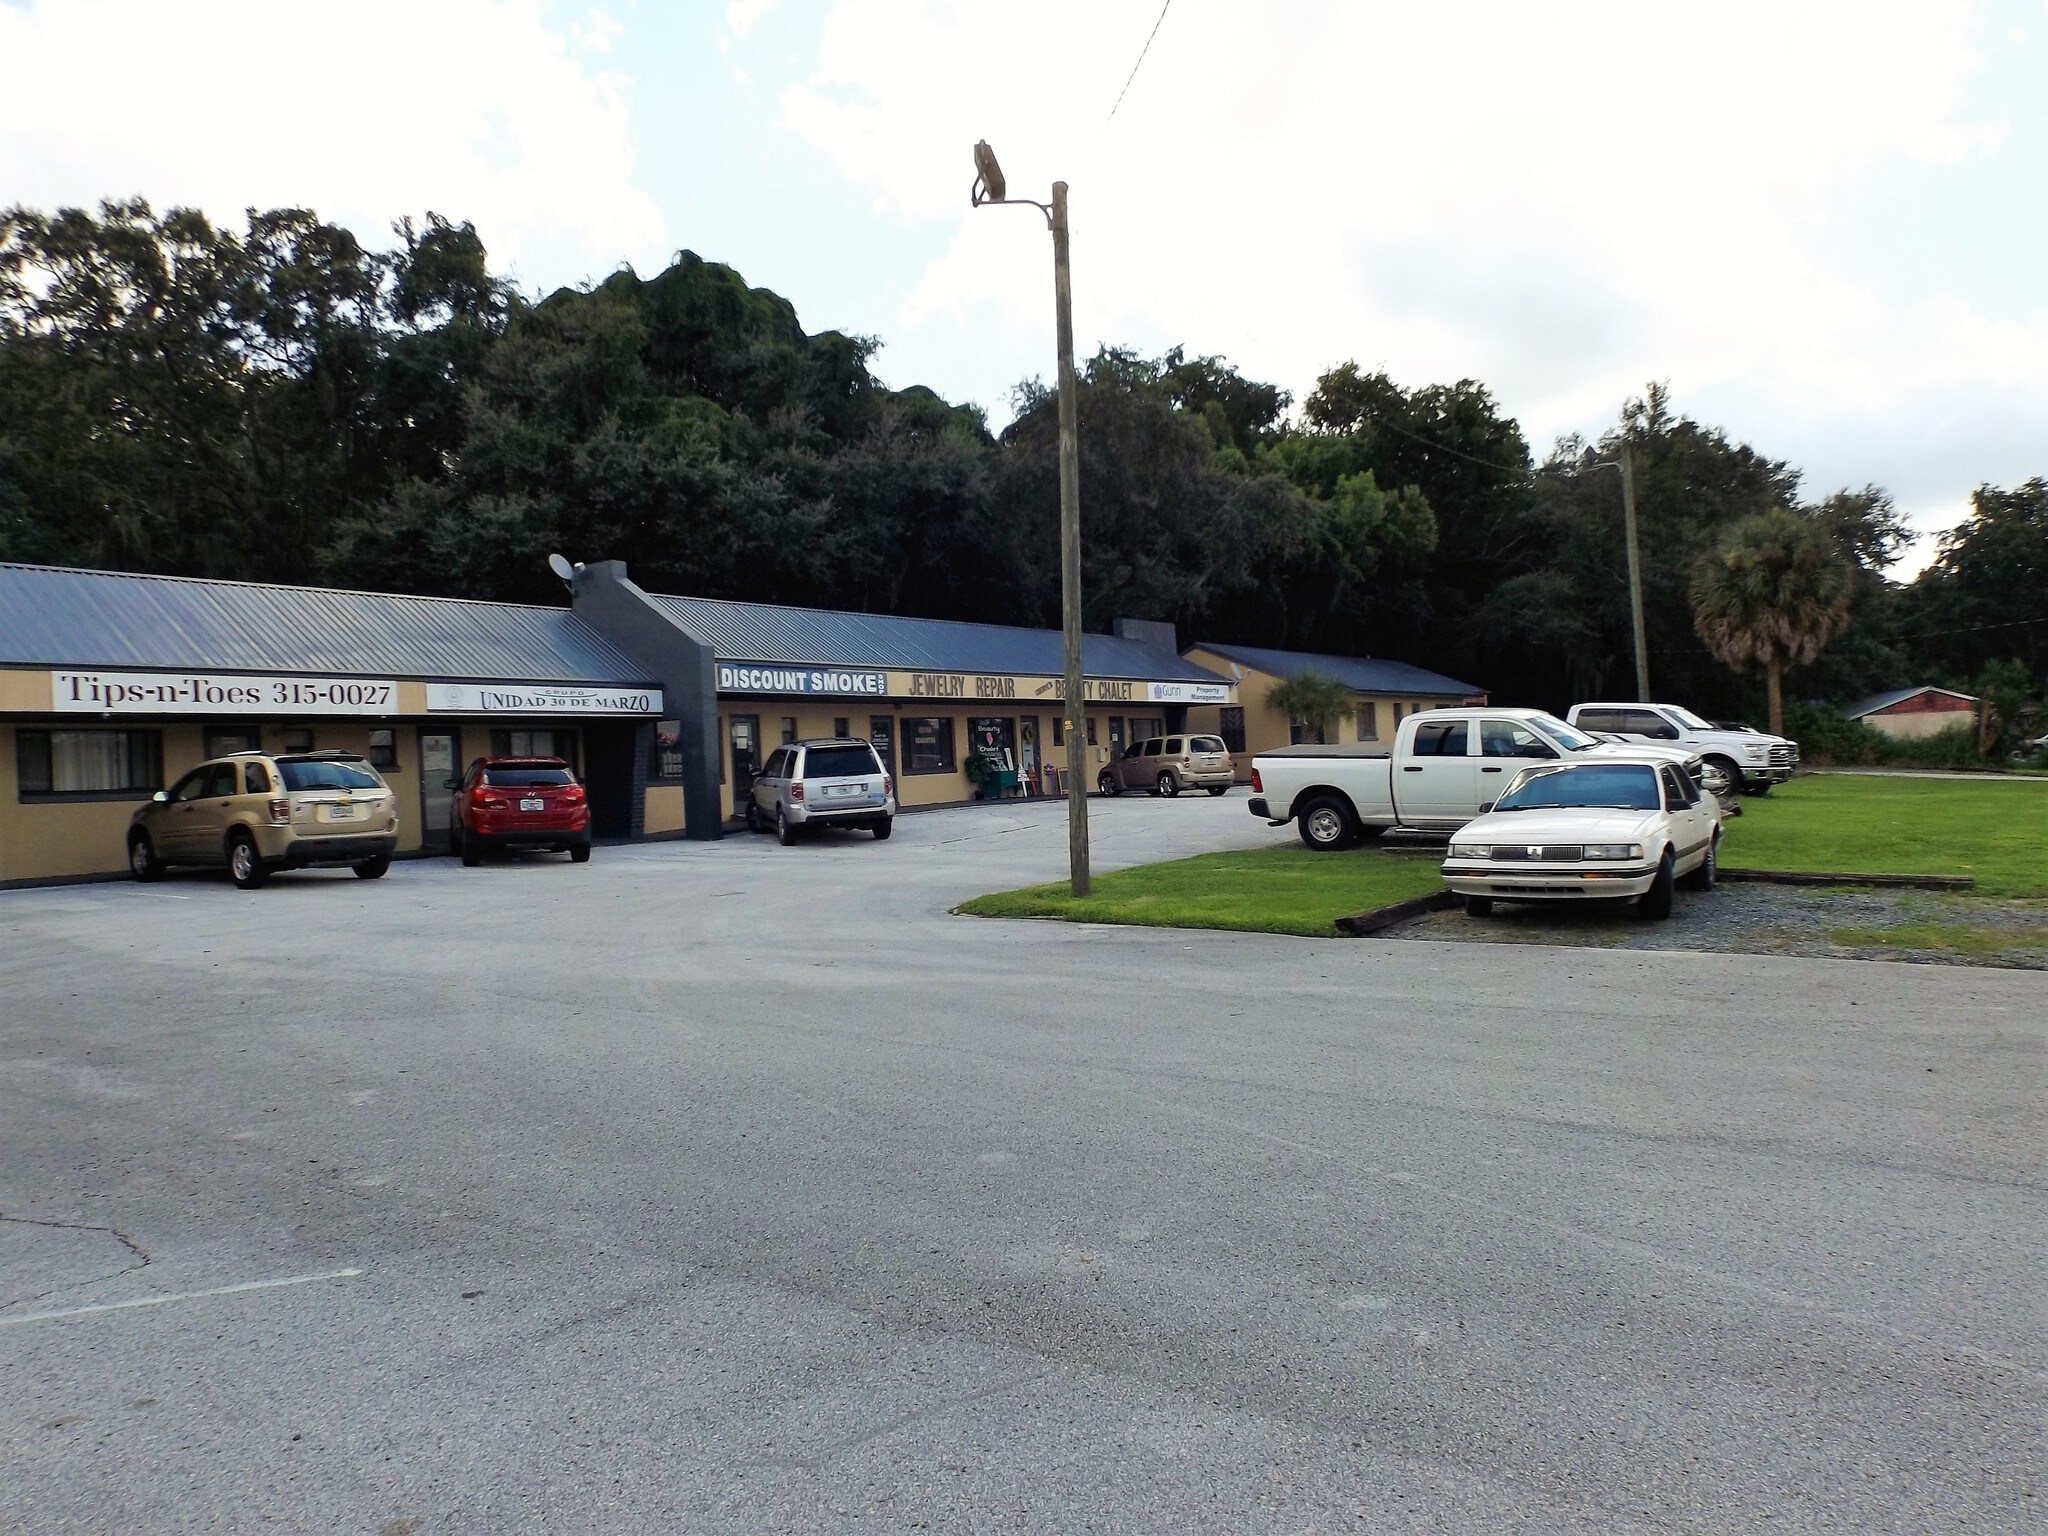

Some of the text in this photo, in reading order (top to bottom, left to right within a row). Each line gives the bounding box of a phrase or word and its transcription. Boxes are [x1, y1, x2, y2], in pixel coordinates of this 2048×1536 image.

[721, 668, 877, 692] DISCOUNT SMOKE
[877, 673, 885, 695] SHOP
[909, 673, 965, 697] JEWELRY
[975, 676, 1016, 698] REPAIR
[1055, 680, 1093, 700] BETY
[1099, 681, 1133, 700] CHALET
[1196, 686, 1220, 694] Property
[61, 675, 391, 708] Tips-n-Toes 315-0027
[1162, 684, 1182, 697] Gunn
[1190, 693, 1226, 701] Management
[479, 691, 650, 712] UNIDAD 30 DE MARZO
[977, 725, 1001, 734] Beauty
